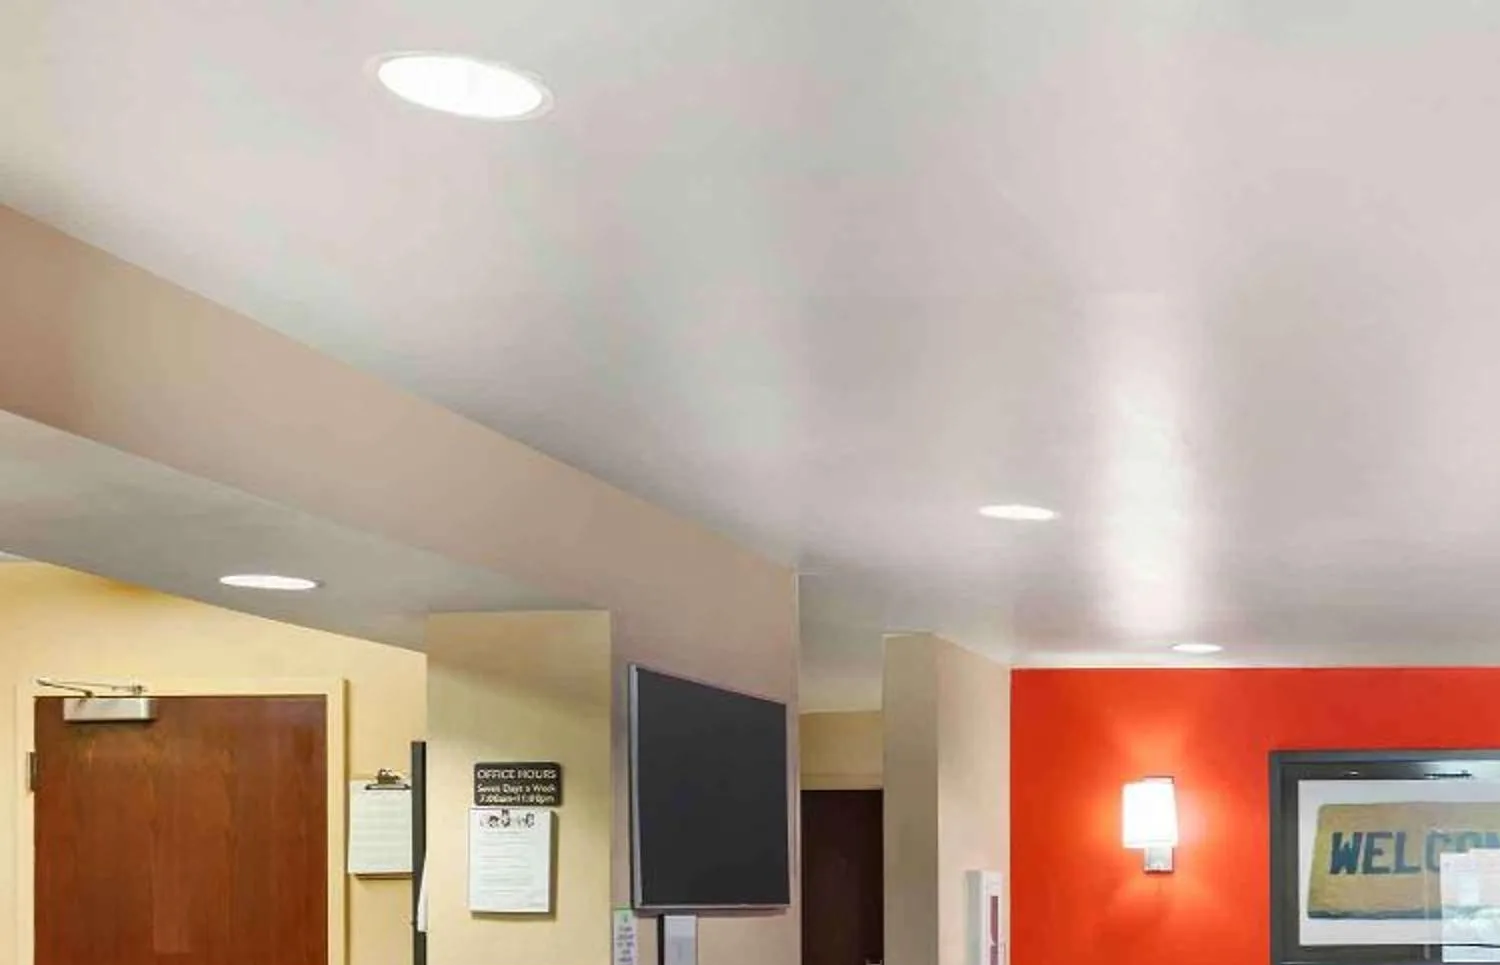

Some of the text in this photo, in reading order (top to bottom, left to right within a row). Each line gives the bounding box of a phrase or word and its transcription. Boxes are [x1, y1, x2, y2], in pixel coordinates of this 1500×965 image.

[477, 769, 557, 779] OFFICE HOURS
[502, 783, 524, 794] Days
[533, 783, 556, 793] Week
